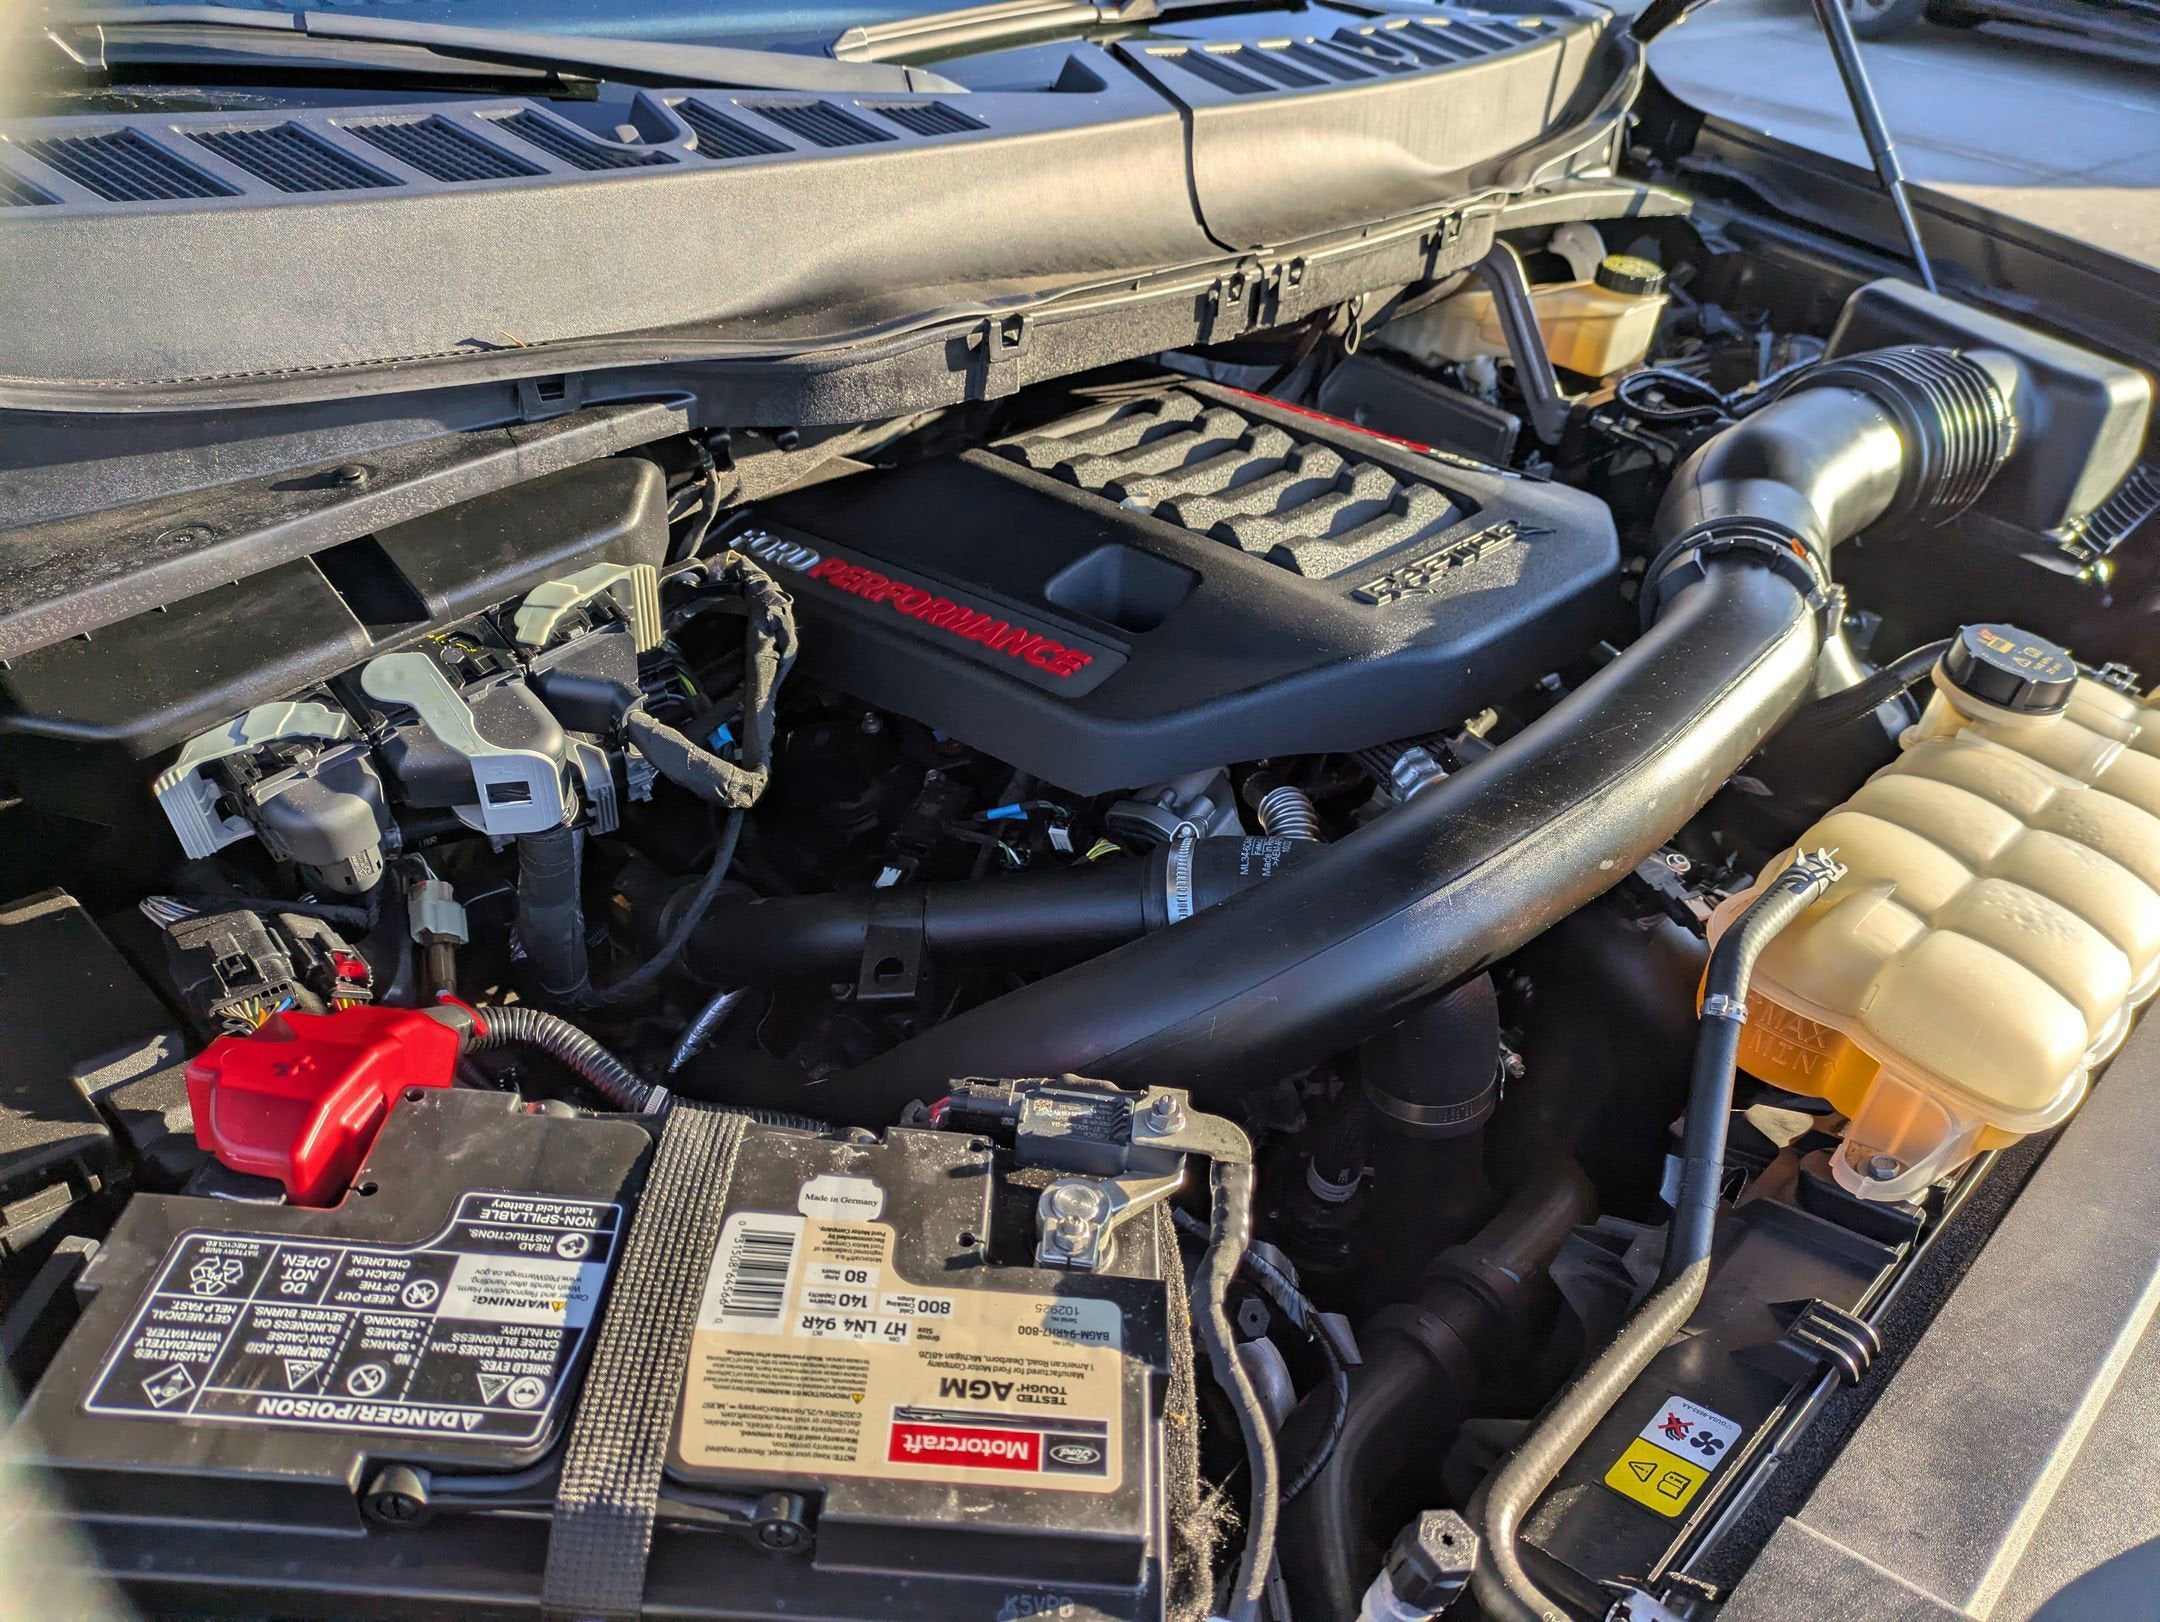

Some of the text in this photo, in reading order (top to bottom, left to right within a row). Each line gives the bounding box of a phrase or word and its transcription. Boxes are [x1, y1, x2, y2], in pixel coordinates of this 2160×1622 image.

[728, 529, 1094, 678] FORD PERFORMANCE
[1760, 1001, 1831, 1049] MAX
[1748, 1029, 1820, 1075] MIN
[805, 1193, 828, 1201] Made
[841, 1197, 878, 1207] Germany
[491, 1199, 593, 1216] Lead Acid Battery
[480, 1209, 596, 1227] NON-SPILLABLE
[469, 1229, 554, 1243] INSTRUCTIONS.
[199, 1246, 259, 1256] BATTERY MUST
[206, 1240, 247, 1249] RECYCLED
[519, 1243, 551, 1252] READ
[281, 1253, 331, 1267] OPEN.
[728, 1238, 745, 1268] 31508
[351, 1255, 411, 1268] CHILDREN.
[207, 1271, 223, 1281] Pb
[281, 1268, 318, 1280] NOT
[346, 1268, 406, 1280] REACH OF
[475, 1268, 582, 1283] www.P65Warnings.ca.gov
[845, 1270, 867, 1283] 80
[281, 1281, 307, 1294] DO
[360, 1281, 401, 1291] OF THE
[471, 1277, 581, 1292] Wash hands after handling.
[719, 1272, 735, 1305] 64566
[335, 1291, 395, 1304] KEEP OUT
[456, 1285, 589, 1301] Cancer and Reproductive Harm.
[808, 1292, 836, 1300] Capacity
[172, 1301, 237, 1314] HELP FAST.
[472, 1296, 550, 1309] WARNING:
[839, 1294, 868, 1308] 140
[886, 1300, 915, 1308] Cranking
[918, 1300, 950, 1314] 800
[152, 1309, 231, 1324] GET MEDICAL
[254, 1306, 347, 1322] SEVERE BURNS.
[1035, 1304, 1079, 1315] 102925
[253, 1318, 341, 1334] BLINDNESS OR
[364, 1315, 419, 1327] SMOKING
[802, 1316, 907, 1336] H7 LN4 94R
[145, 1327, 222, 1341] WITH WATER.
[365, 1327, 414, 1339] FLAMES
[501, 1325, 563, 1337] OR INJURY.
[916, 1332, 940, 1342] Group
[1018, 1325, 1109, 1341] BAGM-94RH7-800
[135, 1337, 218, 1351] IMMEDIATELY
[266, 1332, 335, 1345] CAN CAUSE
[361, 1339, 409, 1351] SPARKS
[452, 1333, 560, 1348] CAUSE BLINDNESS
[133, 1348, 211, 1362] FLUSH EYES
[245, 1342, 330, 1358] SULFURIC ACID
[431, 1342, 556, 1360] EXPLOSIVE GASES CAN
[918, 1351, 943, 1359] 48126
[394, 1353, 411, 1365] NO
[945, 1353, 982, 1362] Michigan
[984, 1355, 1024, 1365] Dearborn,
[1025, 1358, 1048, 1367] Road,
[480, 1360, 551, 1374] SHIELD EYES.
[927, 1360, 1084, 1379] Manufactured for Ford Motor Company
[1050, 1360, 1089, 1370] American
[939, 1378, 1014, 1401] AGM
[1017, 1394, 1067, 1405] TESTED
[256, 1398, 460, 1428] DANGER/POISON
[903, 1434, 1029, 1460] Motorcraft
[1058, 1447, 1092, 1462] Ford
